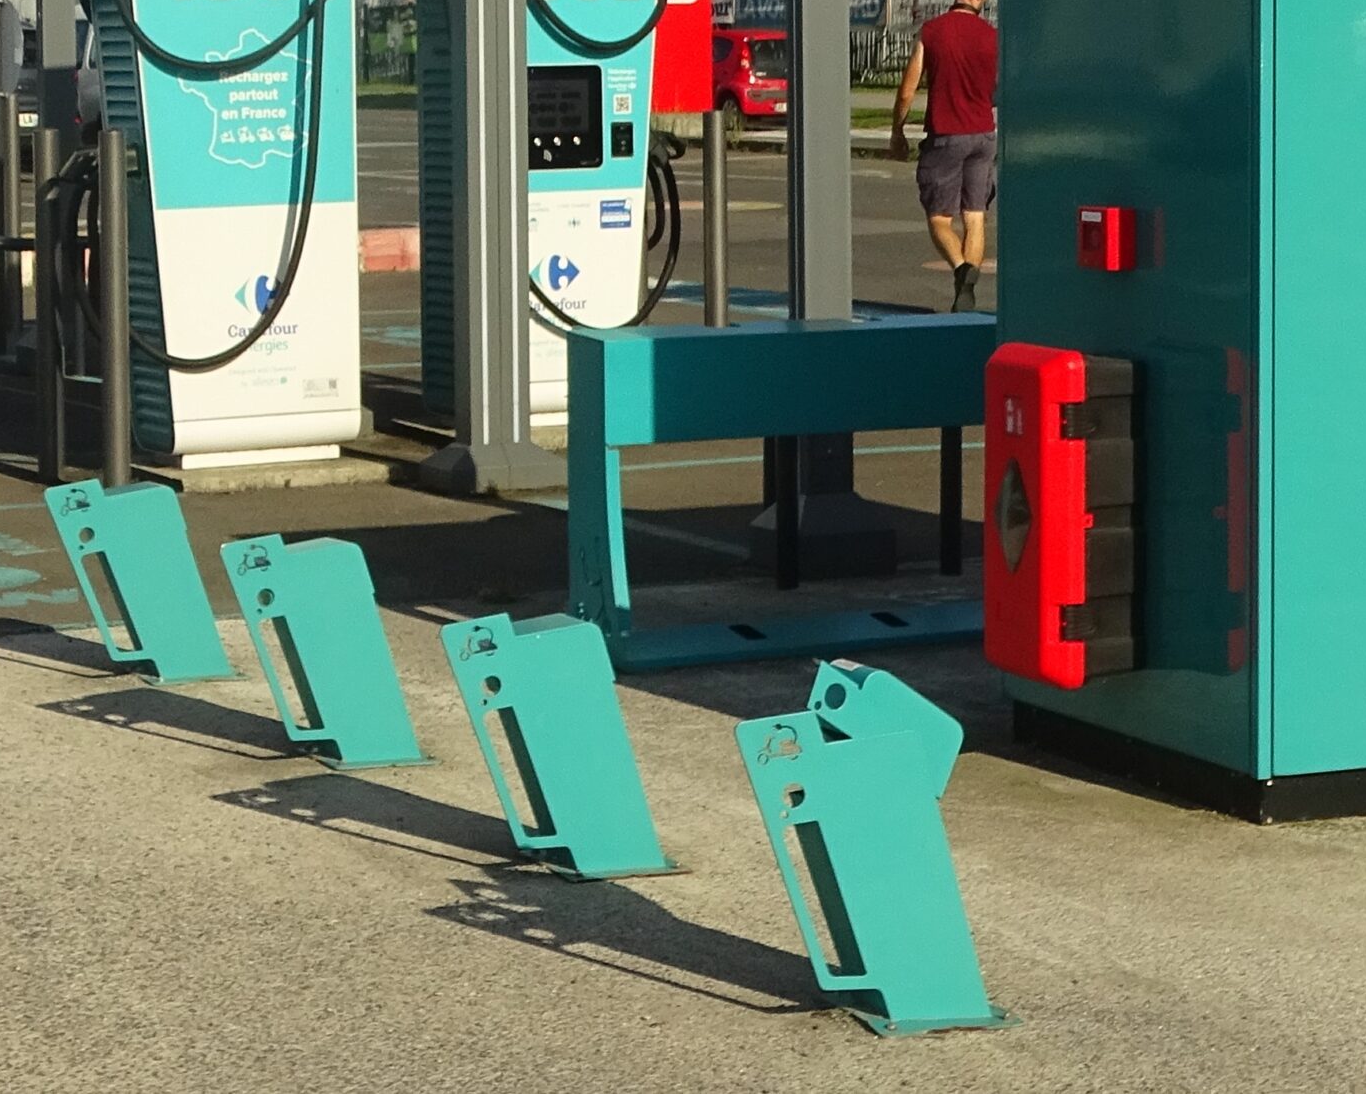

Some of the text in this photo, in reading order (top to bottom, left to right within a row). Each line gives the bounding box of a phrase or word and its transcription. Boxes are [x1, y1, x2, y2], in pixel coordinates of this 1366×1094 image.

[229, 88, 279, 104] partout
[221, 107, 287, 119] en France
